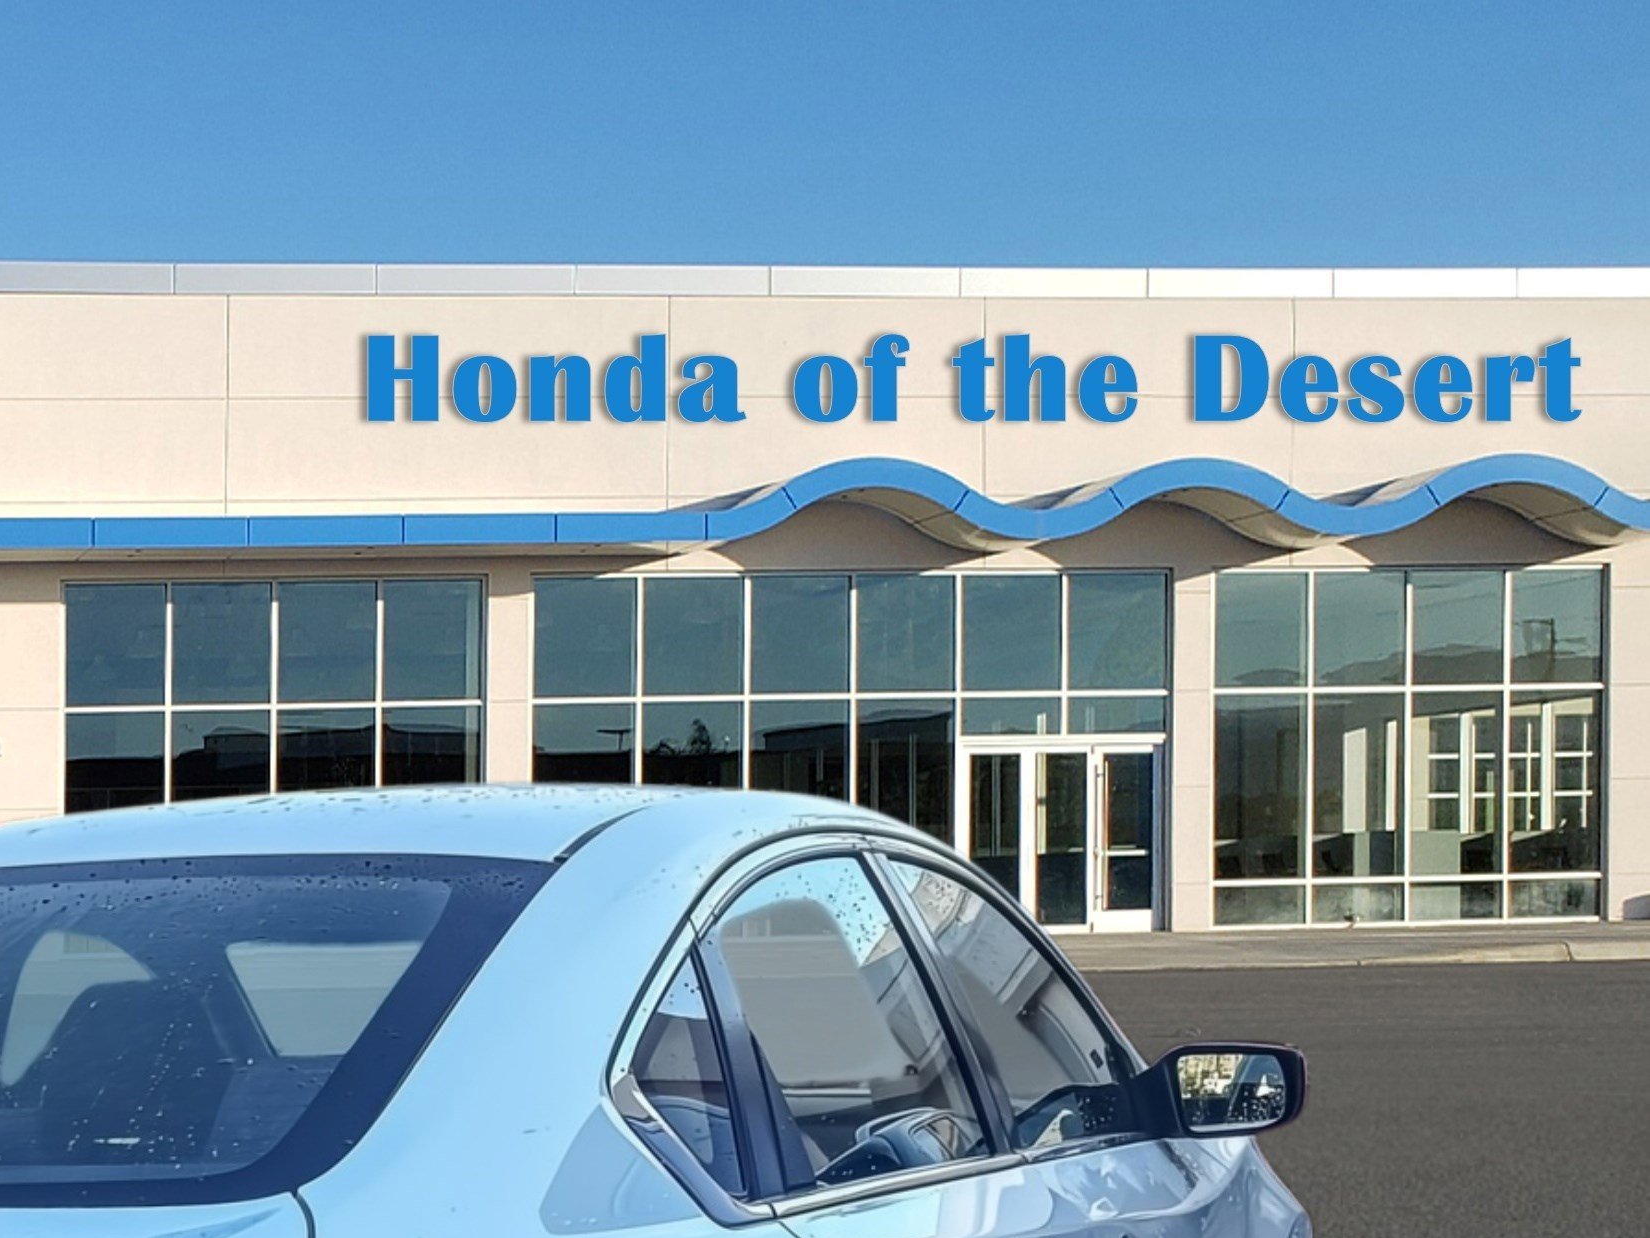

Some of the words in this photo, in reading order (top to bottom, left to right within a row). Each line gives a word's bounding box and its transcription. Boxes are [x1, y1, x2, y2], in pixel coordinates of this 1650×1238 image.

[366, 333, 747, 423] Honda
[793, 333, 911, 423] of
[951, 334, 1139, 423] the
[1193, 334, 1583, 423] Desert
